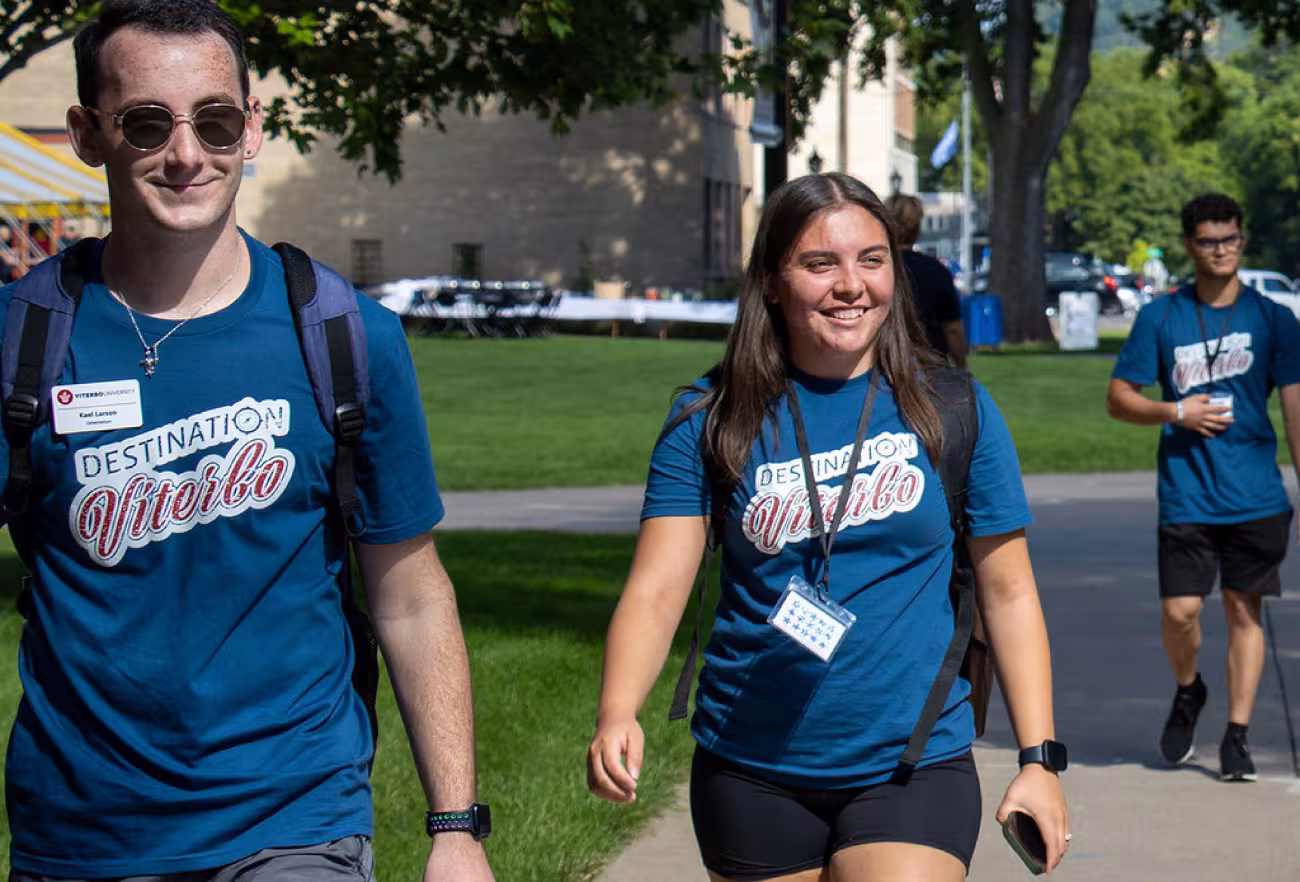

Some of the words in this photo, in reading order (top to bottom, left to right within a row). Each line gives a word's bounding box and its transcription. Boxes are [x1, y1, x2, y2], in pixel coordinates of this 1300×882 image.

[82, 405, 284, 478] DESTINATION
[761, 437, 913, 487] DESINAION
[78, 440, 287, 559] Viterbo
